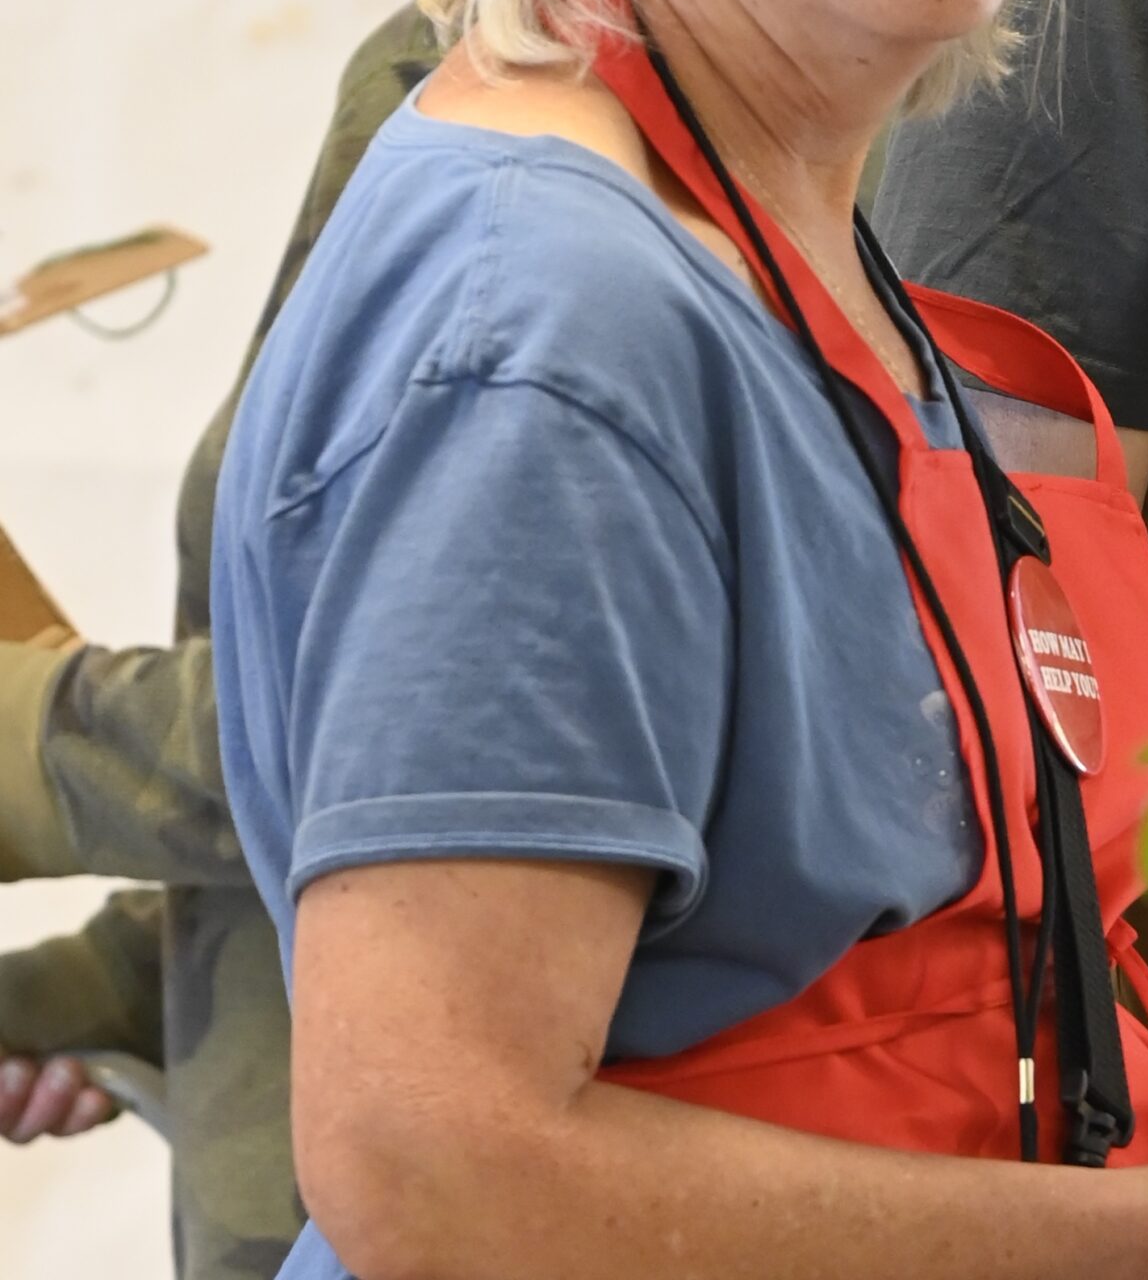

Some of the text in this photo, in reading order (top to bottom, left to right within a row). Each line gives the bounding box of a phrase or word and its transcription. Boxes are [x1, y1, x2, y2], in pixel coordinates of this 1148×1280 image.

[1028, 629, 1092, 665] HOW MAY I
[1040, 666, 1072, 694] HELP
